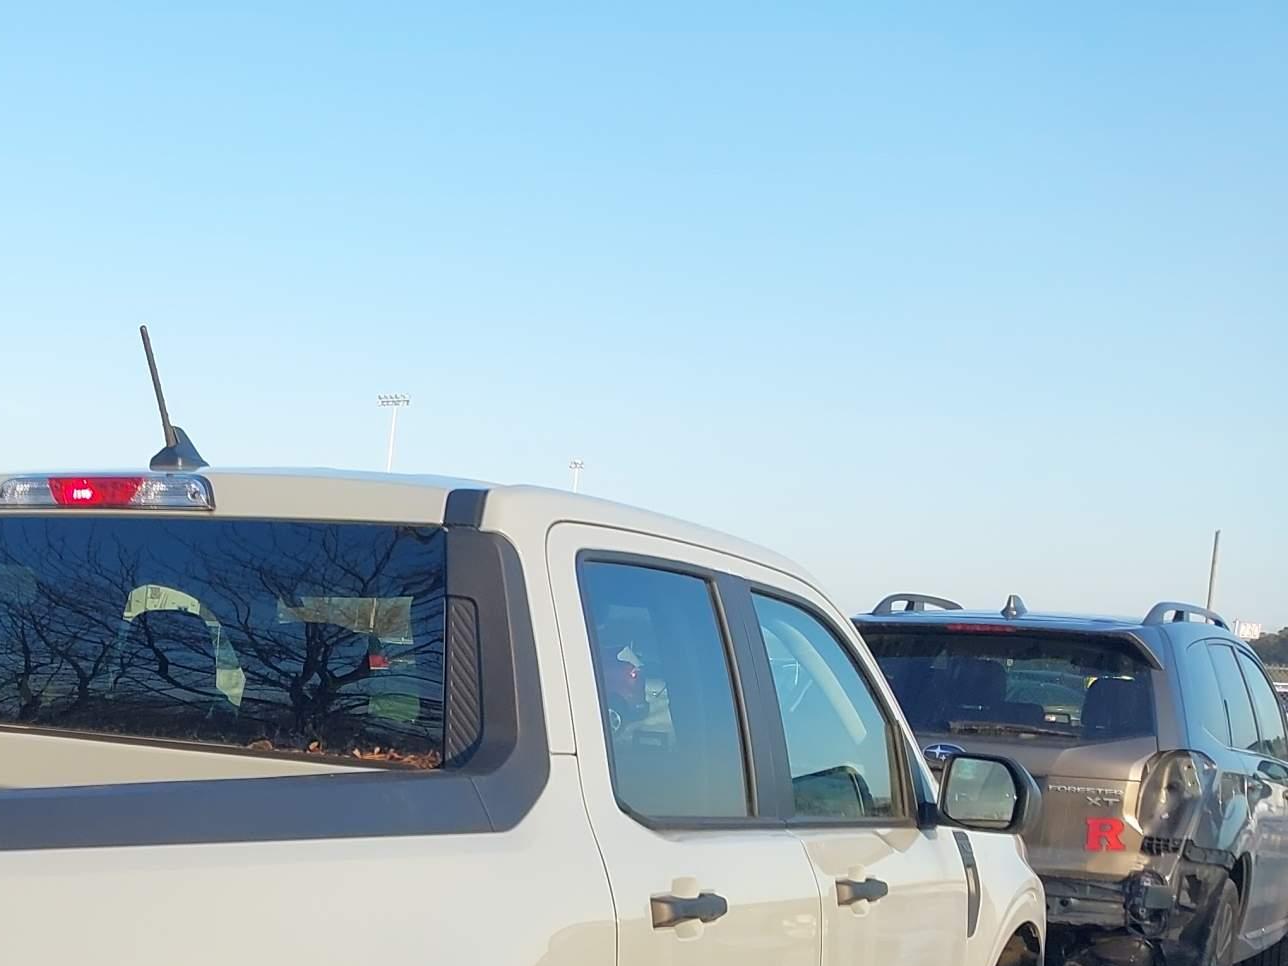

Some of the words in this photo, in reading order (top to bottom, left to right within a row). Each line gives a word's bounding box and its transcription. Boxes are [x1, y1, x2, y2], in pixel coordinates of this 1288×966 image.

[1048, 785, 1124, 795] FORESTER
[1086, 796, 1120, 807] XT
[1085, 816, 1125, 852] R
